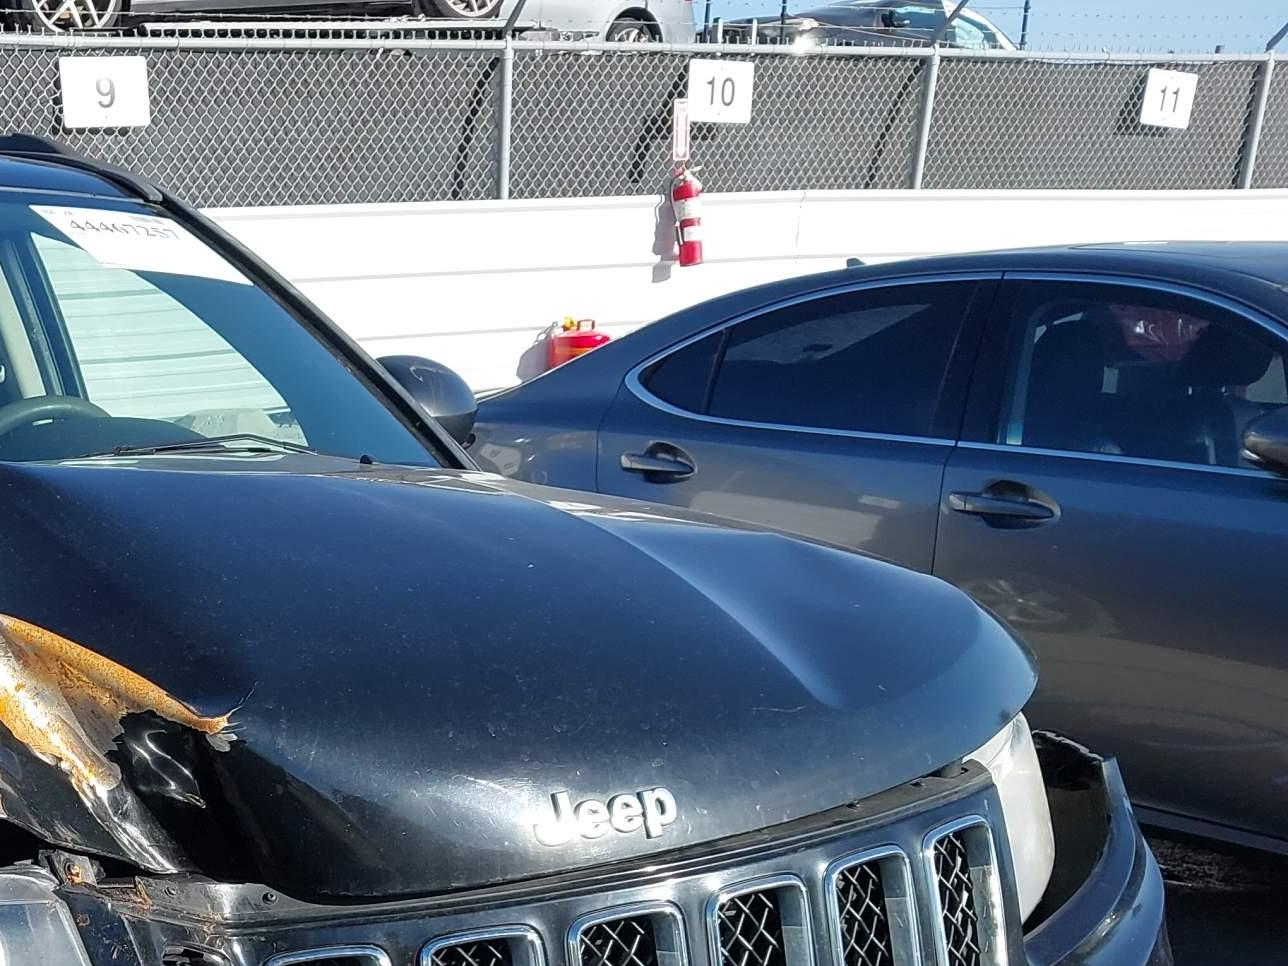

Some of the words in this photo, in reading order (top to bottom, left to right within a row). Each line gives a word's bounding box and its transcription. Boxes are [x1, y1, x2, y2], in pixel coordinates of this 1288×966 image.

[95, 77, 116, 109] 9
[706, 75, 735, 107] 10
[1160, 85, 1180, 113] 11
[533, 787, 677, 847] Jeep
